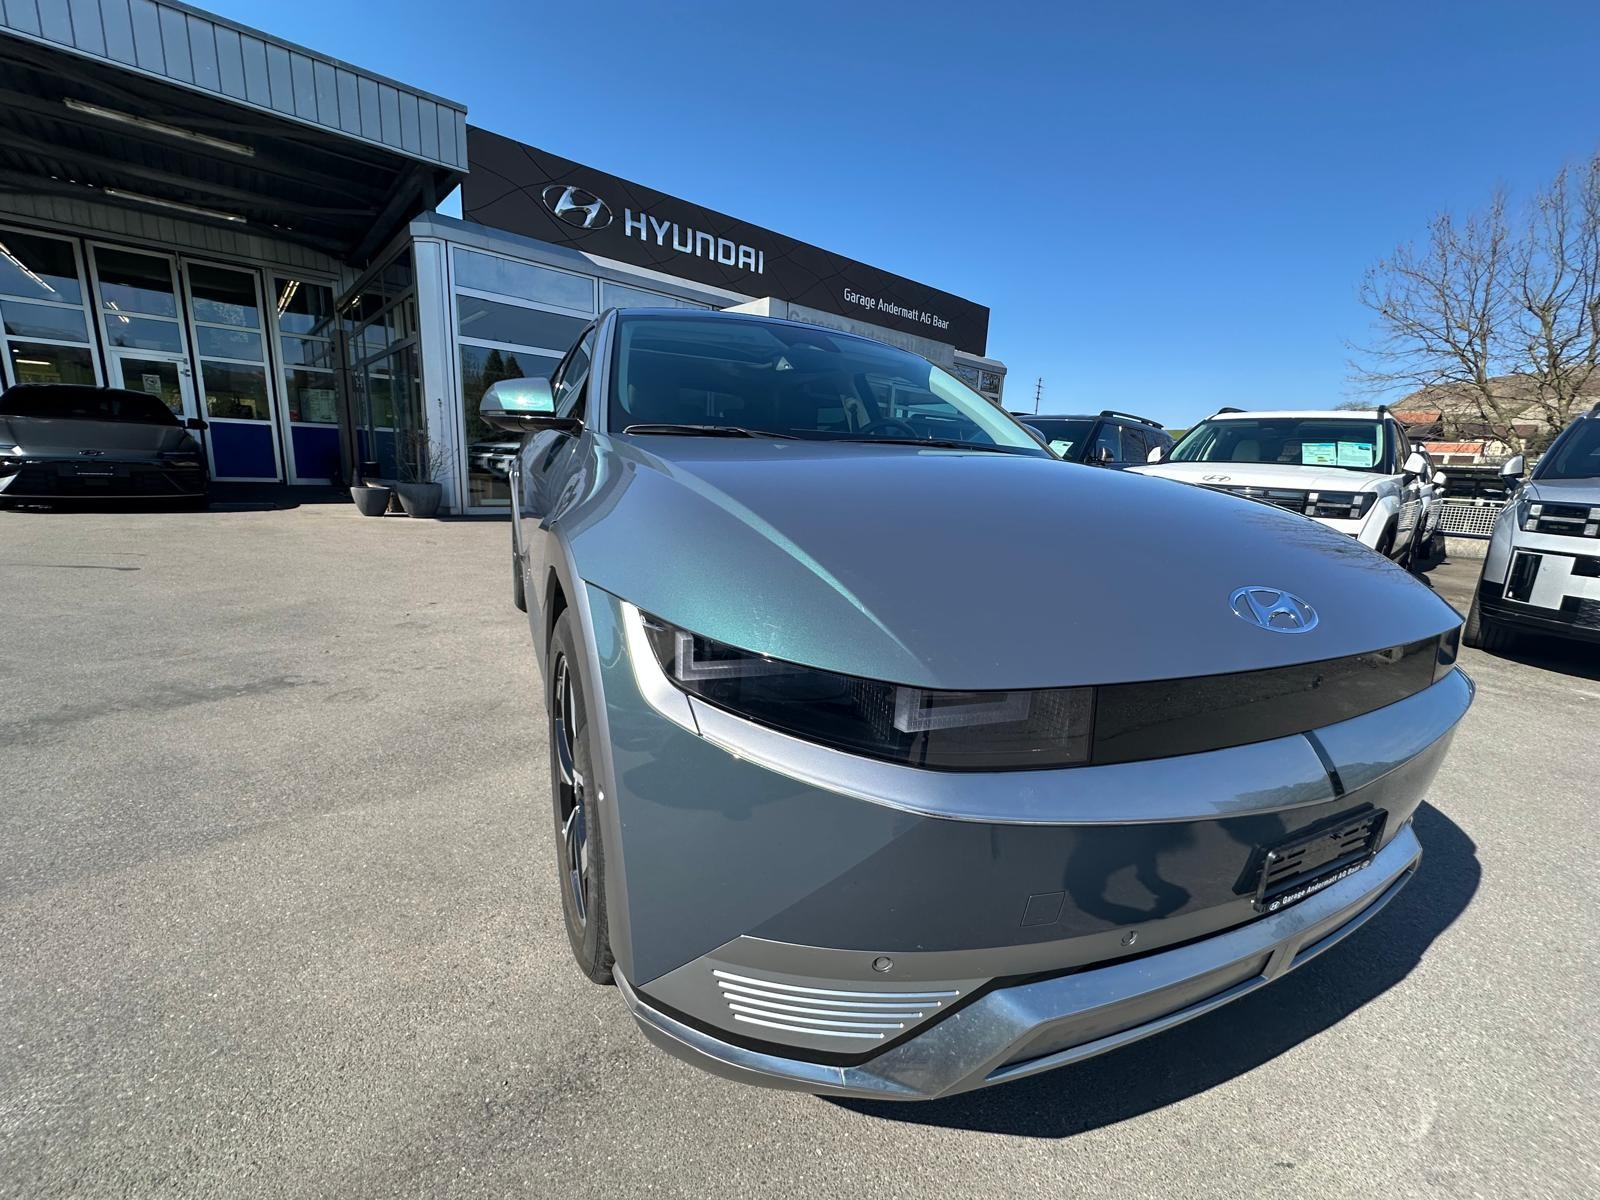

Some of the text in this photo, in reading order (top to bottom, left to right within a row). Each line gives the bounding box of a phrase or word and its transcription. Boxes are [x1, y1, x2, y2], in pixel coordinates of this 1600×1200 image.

[624, 207, 764, 275] HYUNDAI
[843, 288, 950, 330] Garage Andermatt AG Baar
[1282, 865, 1361, 905] Garage Andermatt AG Baar
